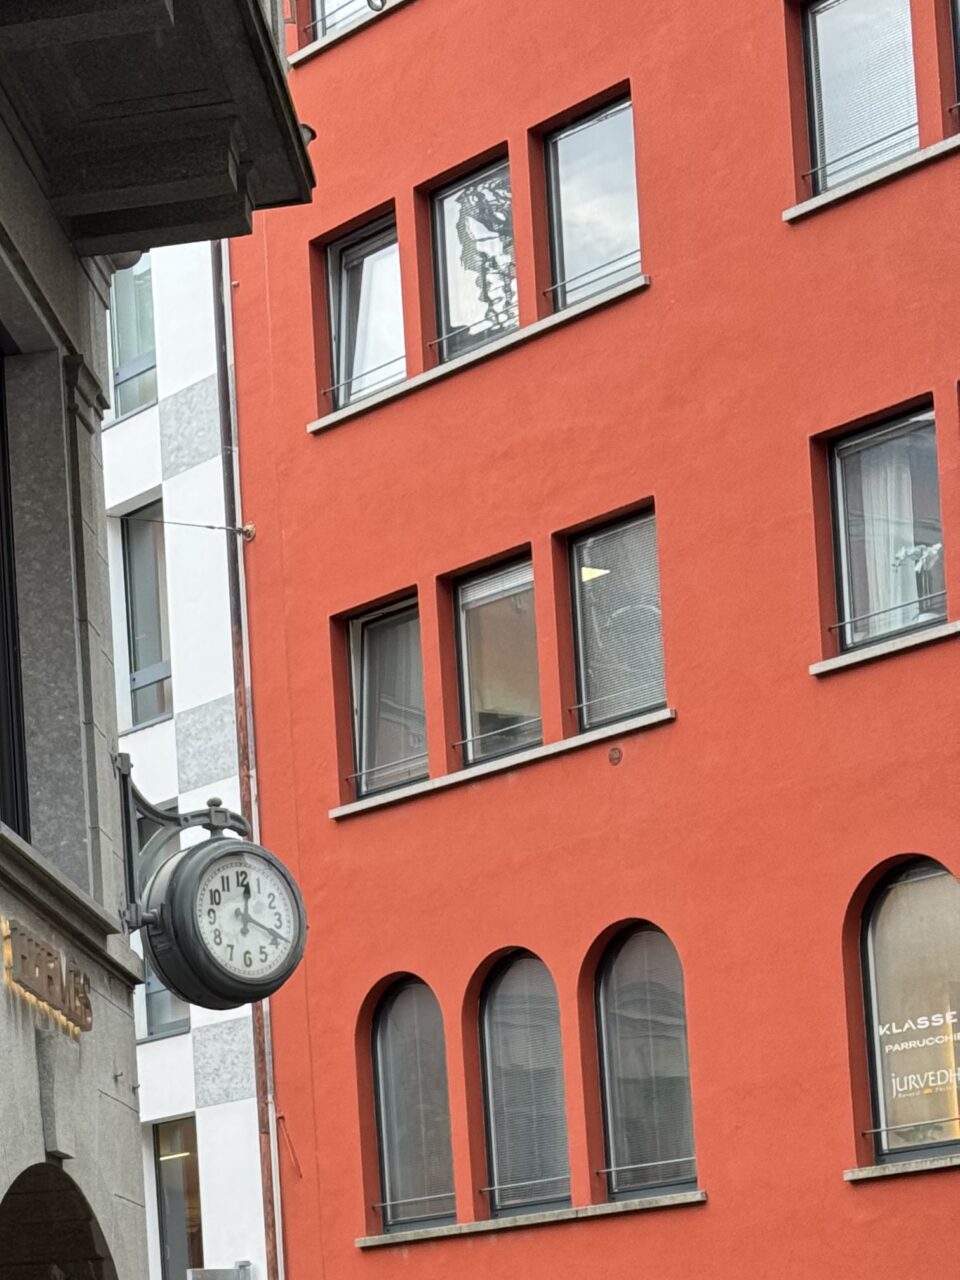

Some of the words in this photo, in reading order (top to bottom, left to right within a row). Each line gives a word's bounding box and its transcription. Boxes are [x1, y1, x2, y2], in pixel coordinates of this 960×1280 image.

[221, 875, 230, 893] 11
[235, 870, 248, 888] 12
[209, 888, 221, 906] 10
[267, 892, 276, 910] 2
[207, 908, 216, 925] 9
[273, 911, 283, 930] 3
[213, 928, 222, 946] 8
[226, 944, 234, 961] 7
[243, 950, 253, 968] 6
[259, 945, 268, 963] 5
[878, 1011, 958, 1036] KLASSE
